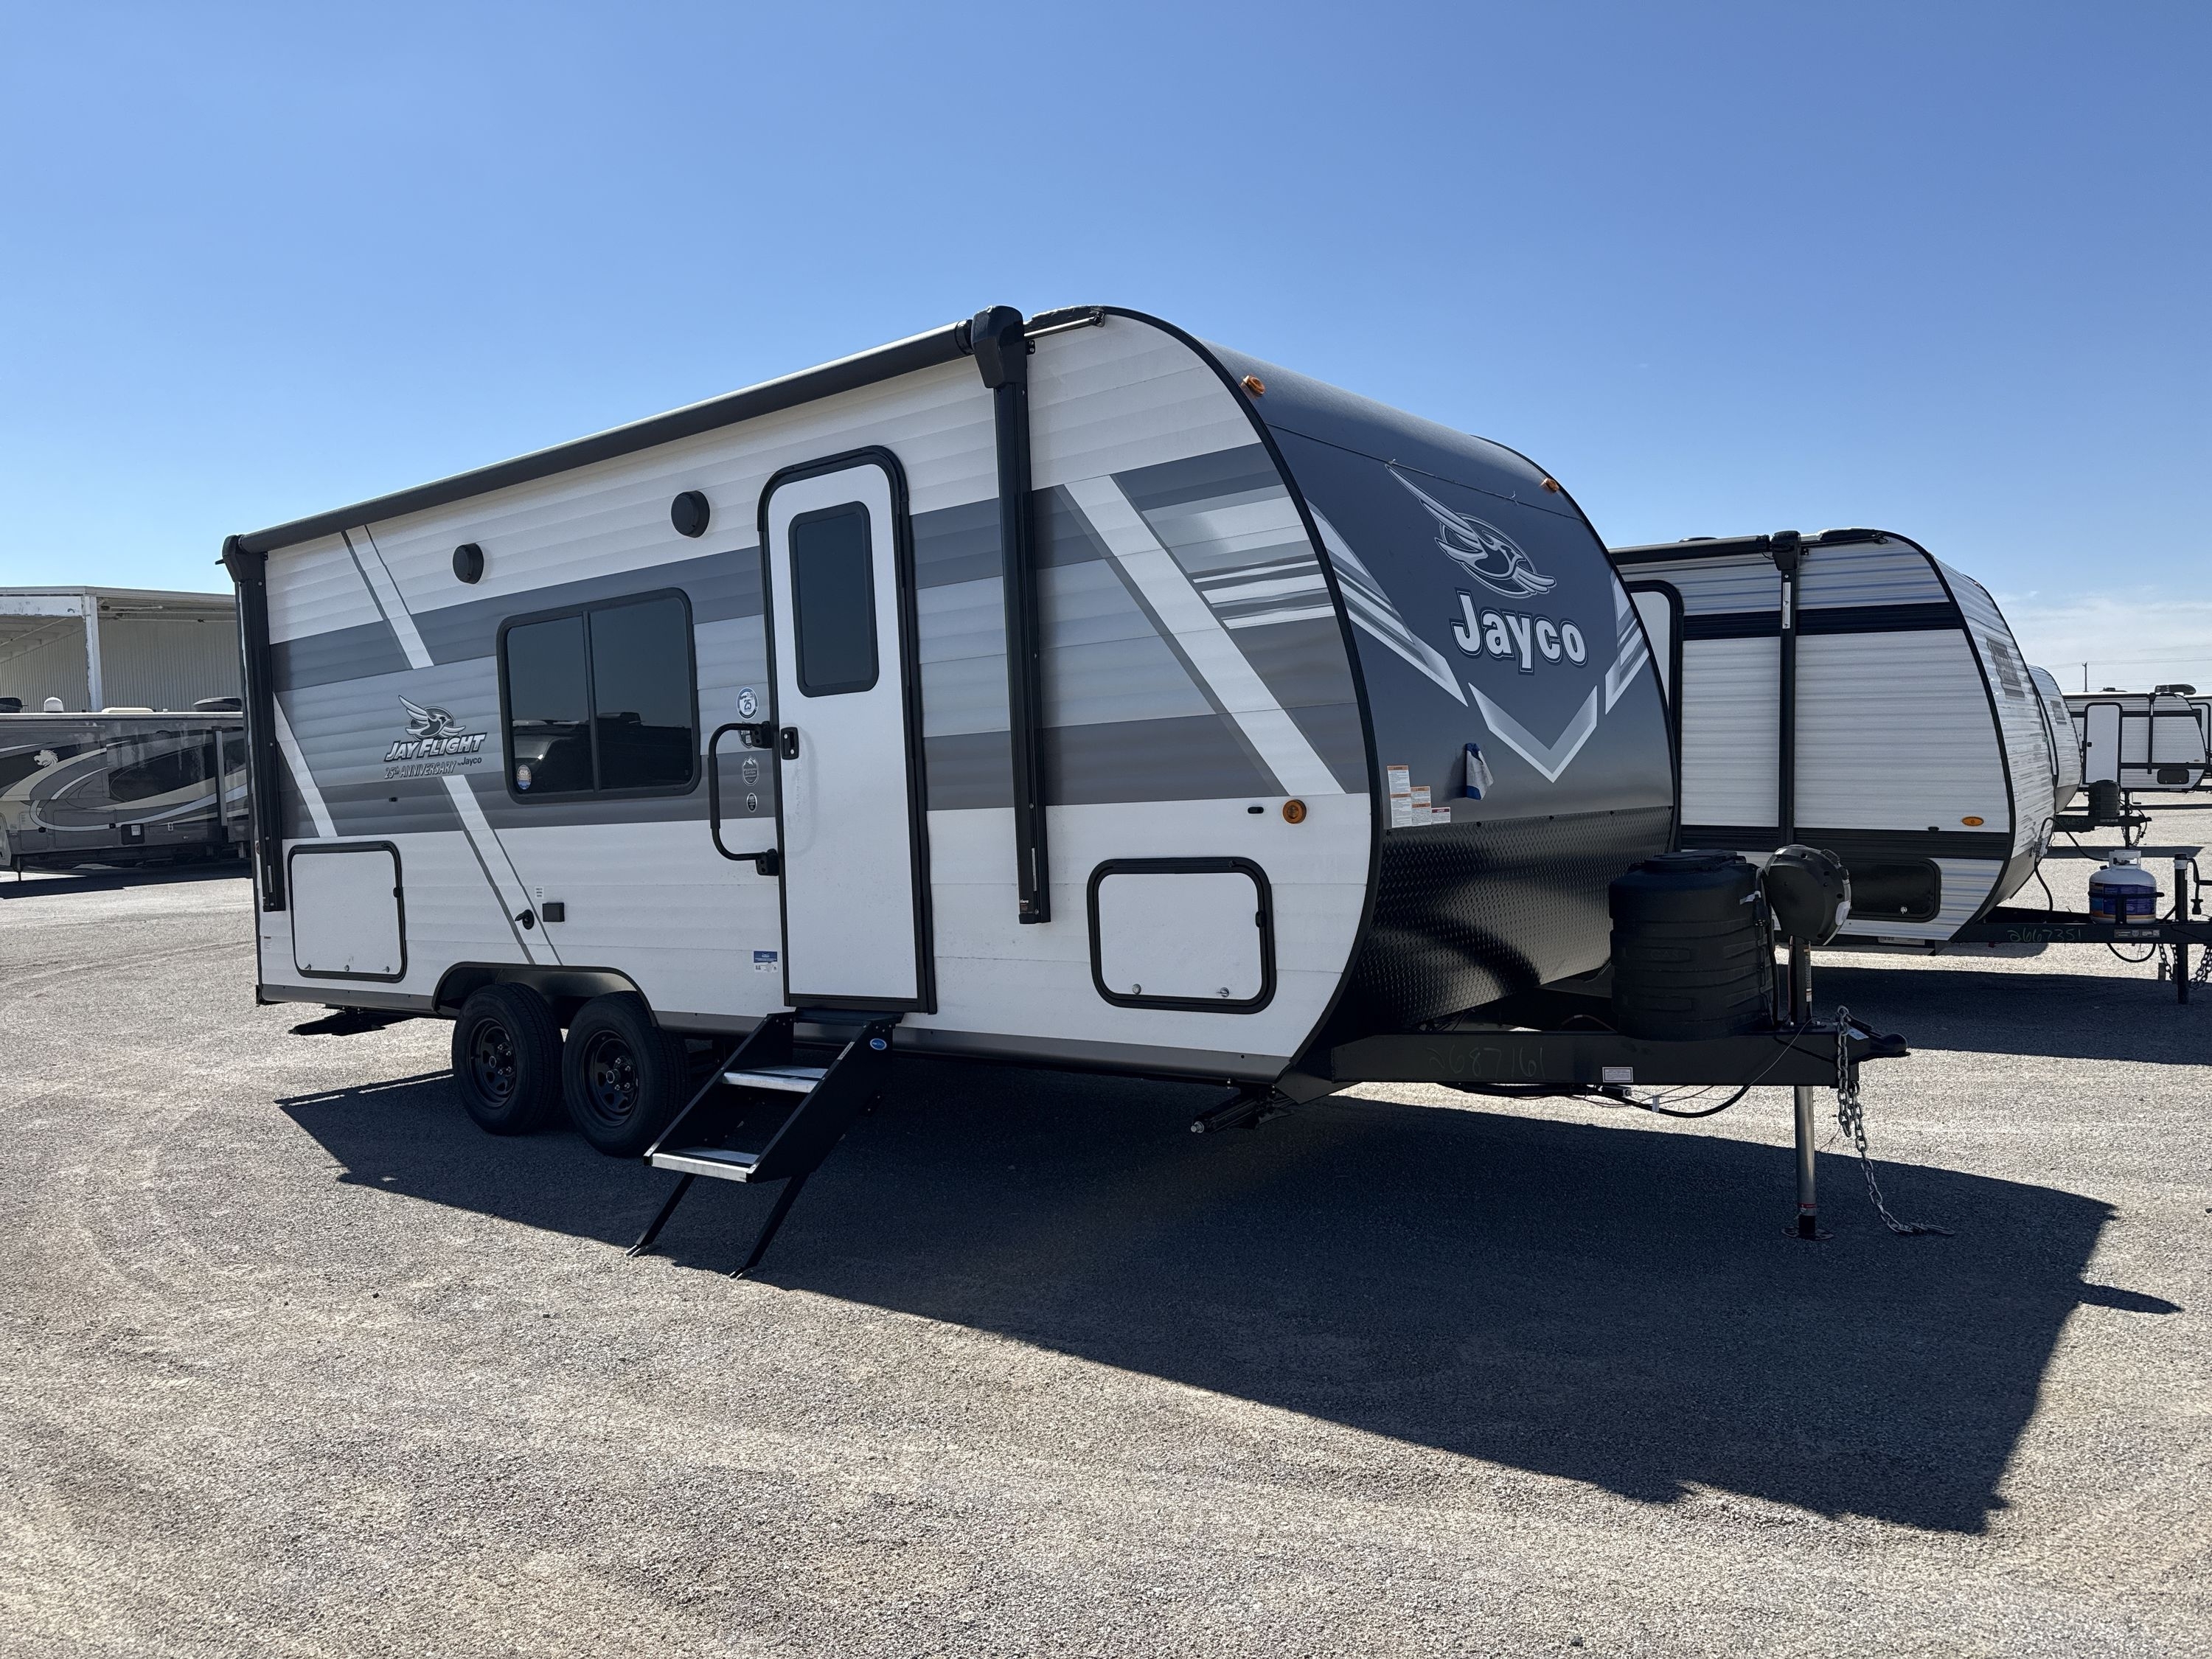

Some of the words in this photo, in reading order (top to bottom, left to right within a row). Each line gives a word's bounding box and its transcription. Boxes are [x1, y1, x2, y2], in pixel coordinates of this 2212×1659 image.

[1450, 591, 1587, 673] Jayco
[744, 699, 752, 710] 25
[384, 740, 420, 762] JAY
[418, 732, 487, 757] FLIGHT
[462, 757, 482, 766] Jayco
[384, 765, 400, 779] 25th
[400, 761, 457, 778] ANNIVERSARY
[2007, 927, 2081, 942] 2667351
